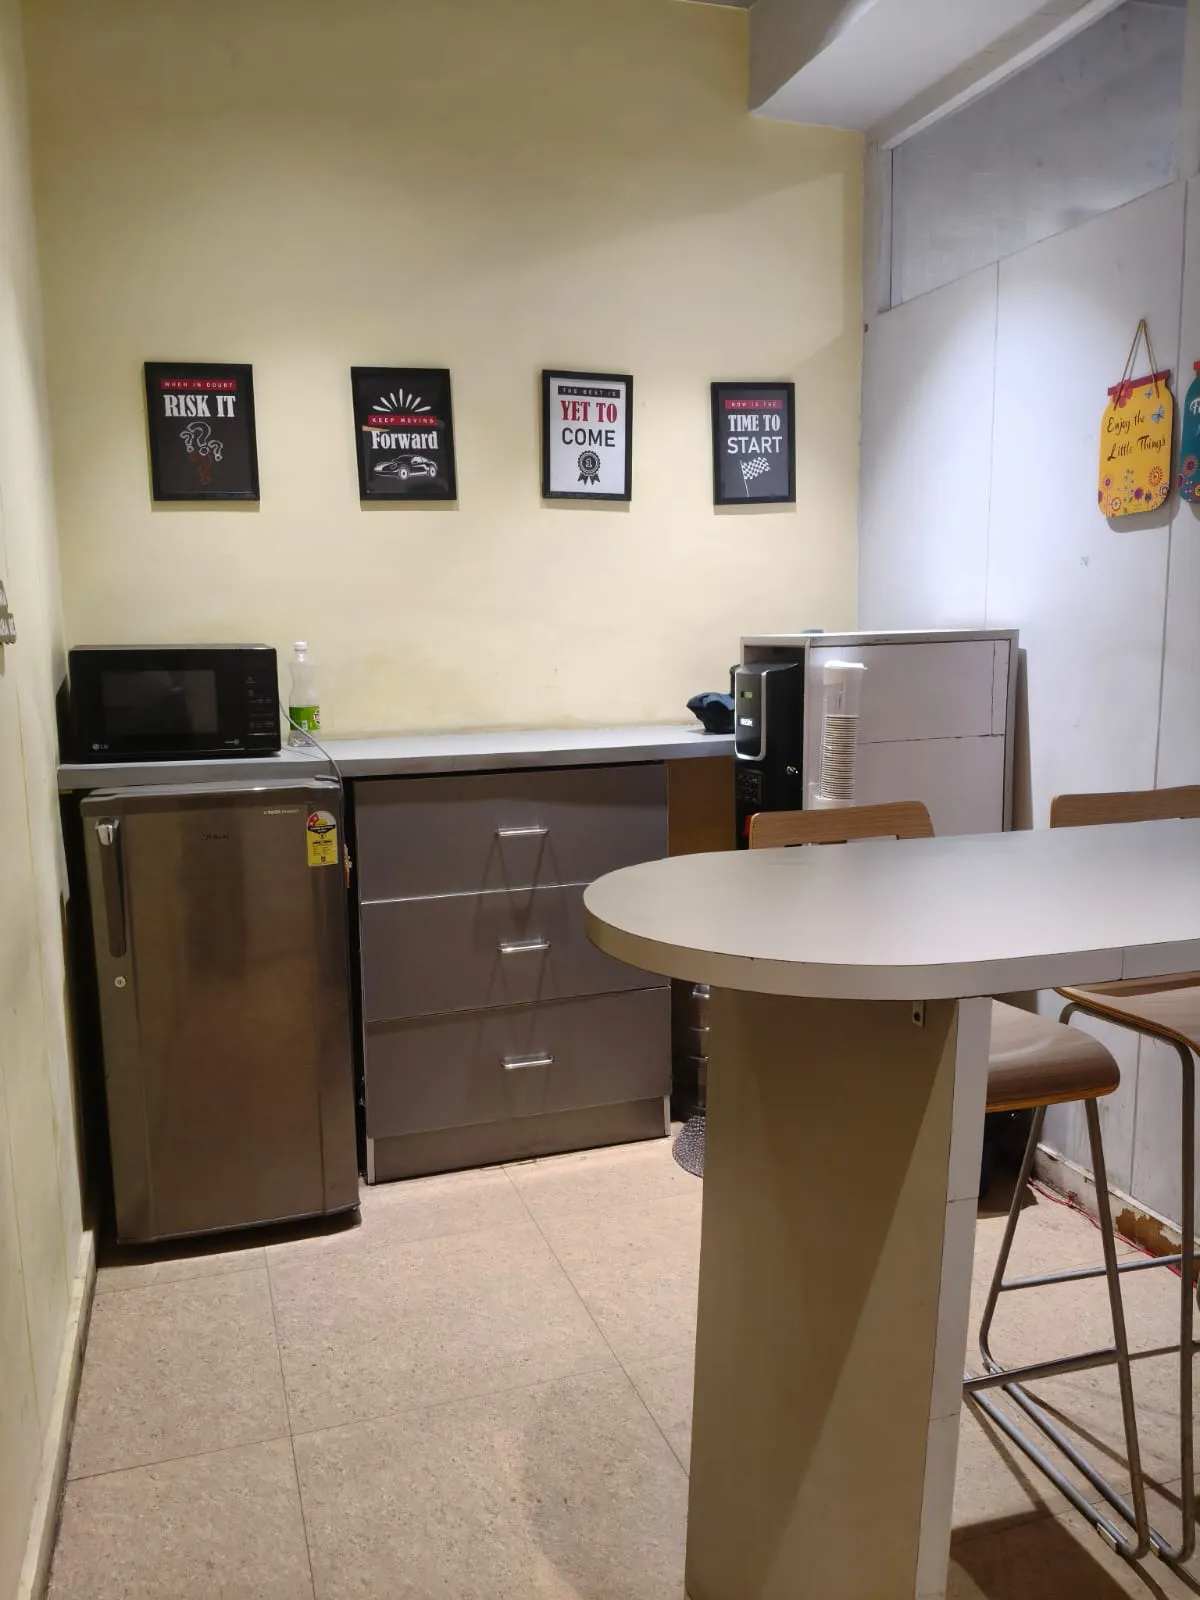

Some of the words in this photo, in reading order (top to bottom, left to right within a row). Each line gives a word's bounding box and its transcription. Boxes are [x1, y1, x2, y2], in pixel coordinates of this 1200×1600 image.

[163, 394, 211, 417] RISK
[216, 395, 236, 418] IT
[560, 400, 590, 421] YET
[596, 402, 618, 423] TO
[728, 414, 760, 432] TIME
[763, 414, 781, 431] TO
[1107, 416, 1131, 435] Enjoy
[1134, 409, 1146, 426] the
[371, 431, 439, 449] Forward
[561, 427, 616, 447] COME
[727, 436, 783, 454] START
[1107, 442, 1132, 461] Little
